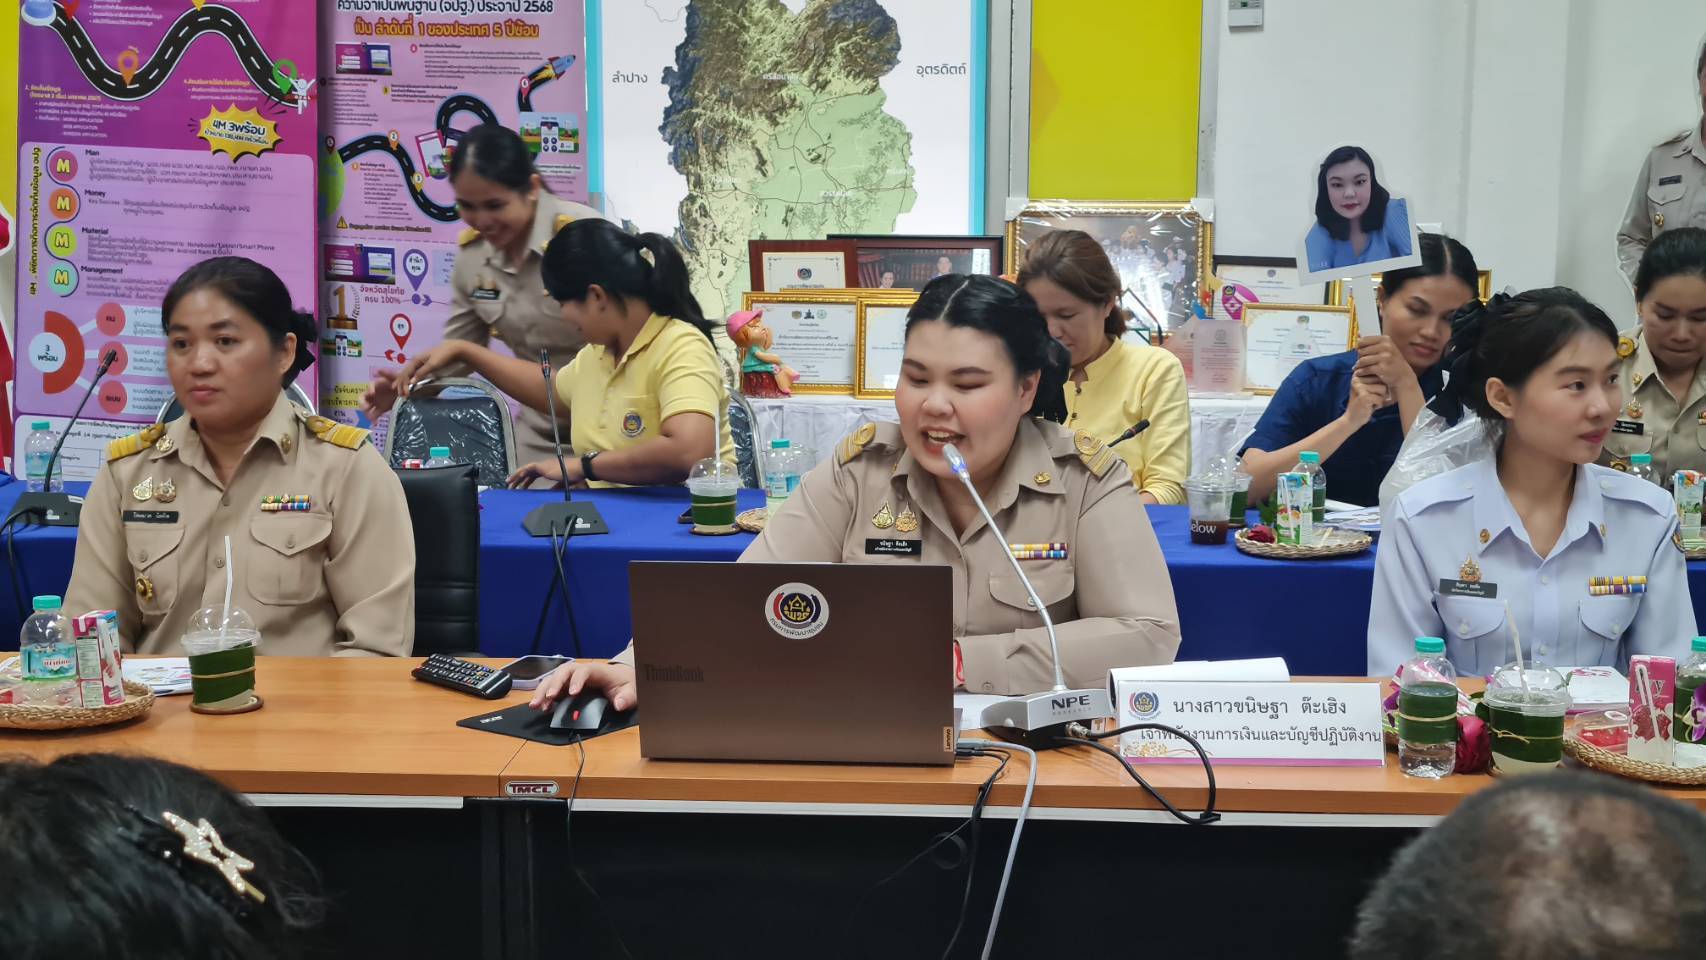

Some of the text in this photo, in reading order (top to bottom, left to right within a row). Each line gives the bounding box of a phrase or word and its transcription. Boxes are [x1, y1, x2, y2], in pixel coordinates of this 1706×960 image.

[337, 0, 553, 15] ความจำเปนพนฐาน (จปฐ.) ประจำป 2568
[354, 13, 540, 37] เป็น ลำดับที่ 1 ของประเทศ 5 ปีซ้อน
[611, 70, 648, 84] ลำปาง
[916, 62, 967, 77] อุตรดิตถ์
[213, 120, 226, 130] 4M
[56, 158, 70, 174] M
[84, 189, 106, 198] Money
[56, 196, 70, 211] M
[81, 227, 109, 235] Material
[55, 231, 70, 248] M
[54, 269, 69, 285] M
[80, 265, 123, 275] Management
[360, 285, 405, 296] จังหวัดสุโขทัย
[381, 296, 401, 305] 100%
[643, 663, 705, 681] ThinkBook
[1051, 694, 1091, 710] NPE
[1172, 695, 1289, 719] นางสาวขนิษฐา
[1301, 696, 1347, 714] ต๊ะเฮิง
[1141, 725, 1382, 746] เจาพนักงานการเงินและบัญชีปฏิบัติงาน
